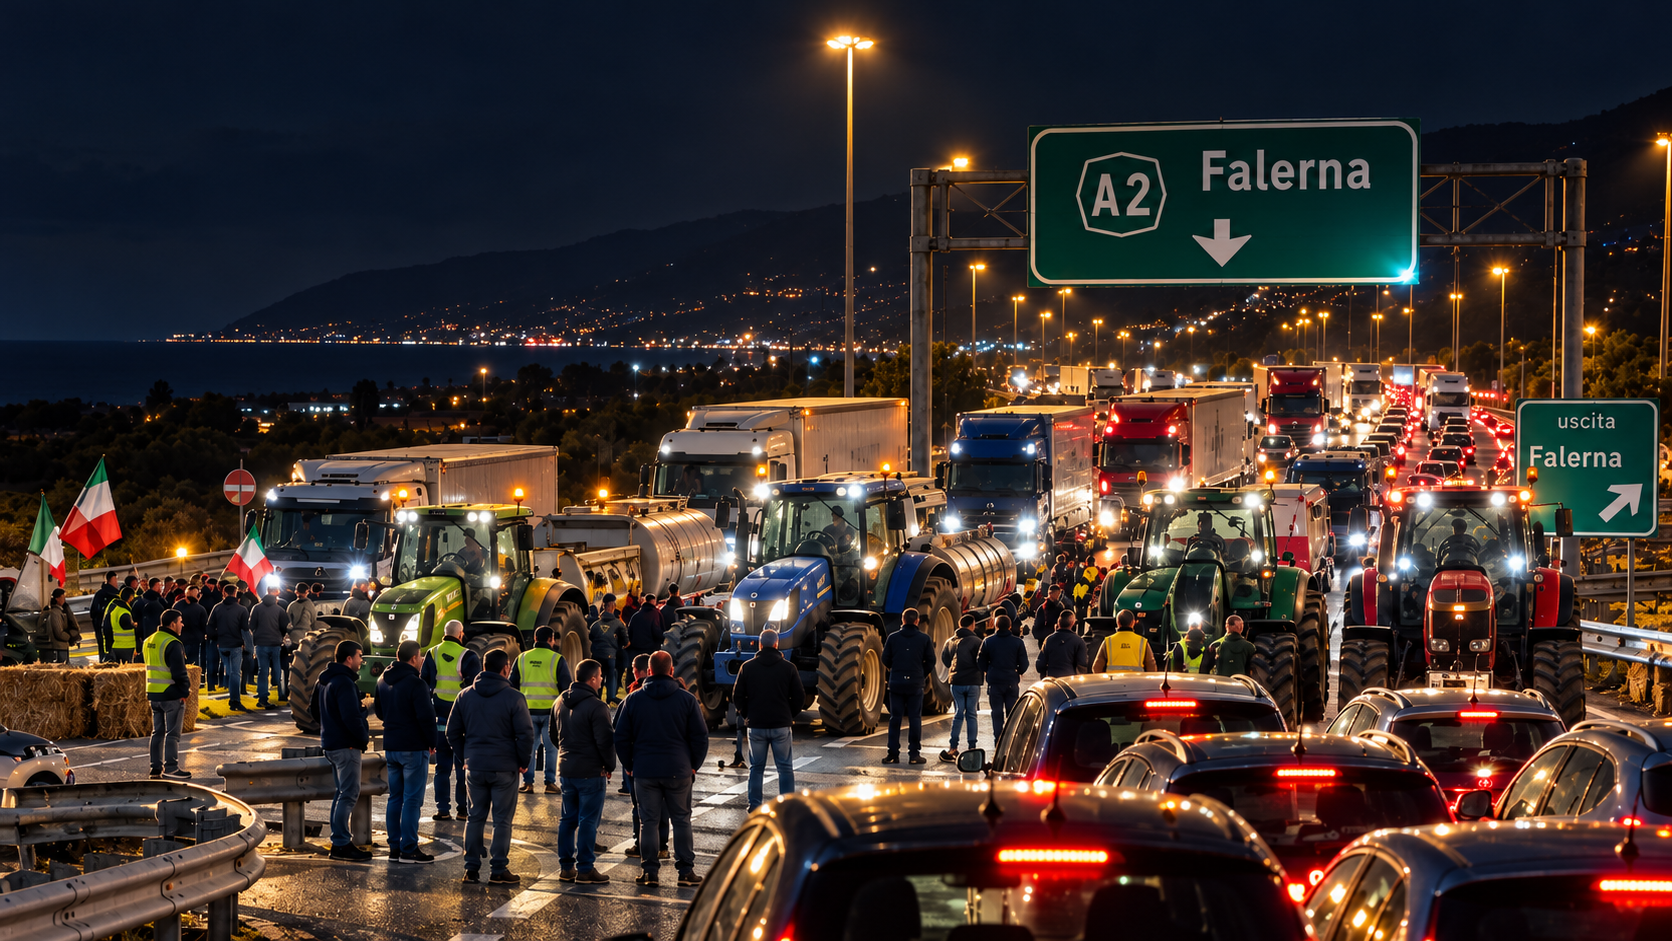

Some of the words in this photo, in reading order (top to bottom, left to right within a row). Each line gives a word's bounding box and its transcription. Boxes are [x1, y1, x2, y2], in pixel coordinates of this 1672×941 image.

[1202, 149, 1371, 191] Falerna
[1091, 172, 1151, 217] A2
[1558, 412, 1616, 429] uscita
[1529, 445, 1623, 468] Falerna
